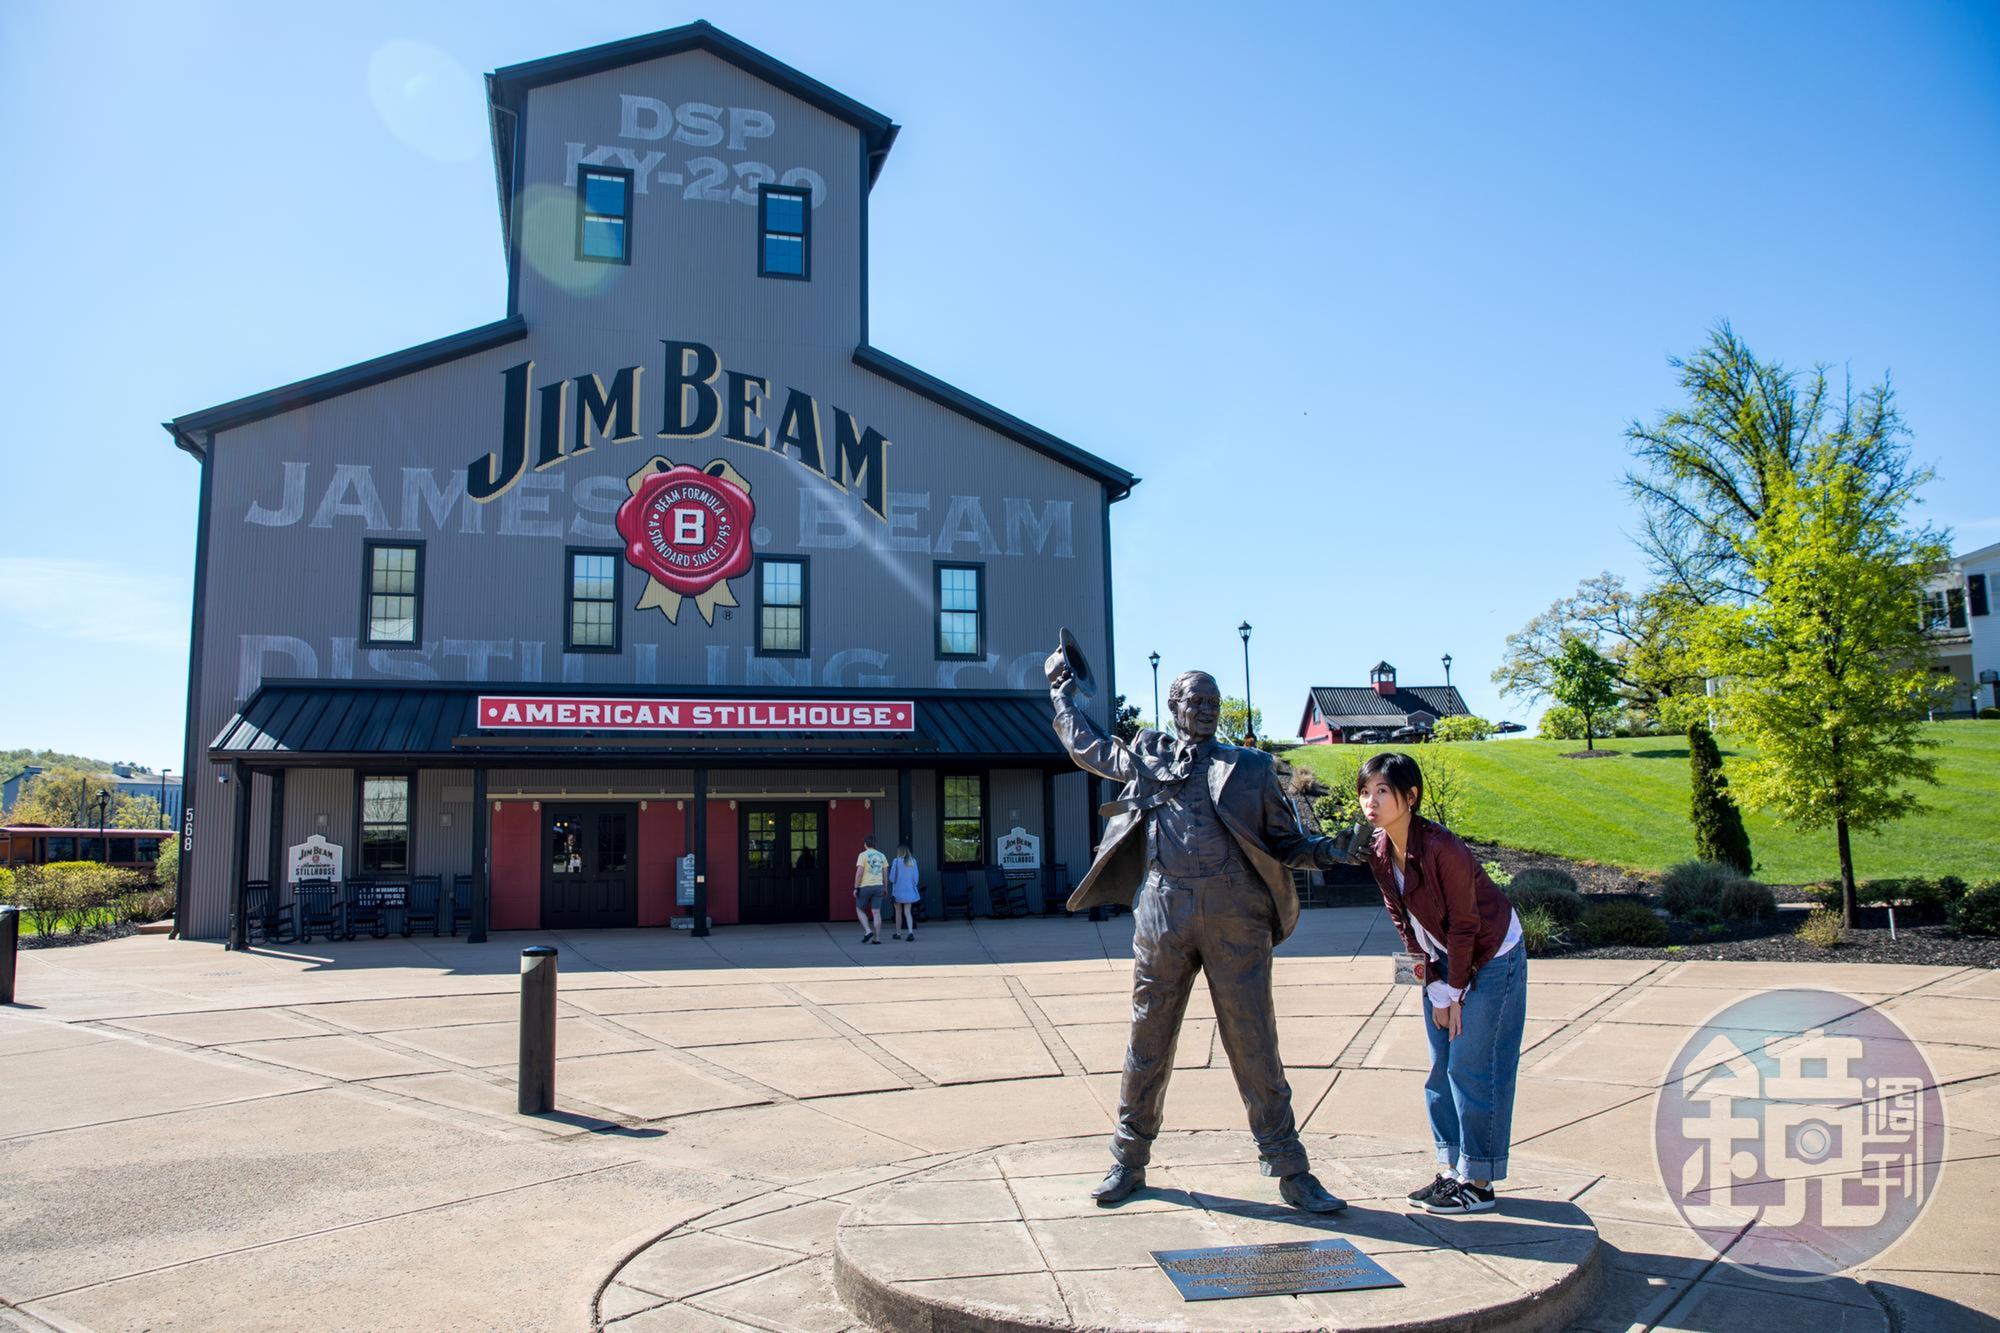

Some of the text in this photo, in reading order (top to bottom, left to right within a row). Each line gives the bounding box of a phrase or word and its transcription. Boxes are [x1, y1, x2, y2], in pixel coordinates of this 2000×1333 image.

[619, 94, 775, 150] DSP
[467, 339, 892, 522] JIM BEAM
[244, 461, 629, 540] JAMES
[655, 487, 725, 516] BEAM FORMULA
[797, 486, 1075, 559] BEAM
[649, 529, 690, 567] STANDARD
[693, 548, 720, 567] SINCE
[714, 524, 731, 550] 1795
[673, 508, 705, 545] B
[501, 703, 892, 725] AMERICAN STILLHOUSE
[184, 807, 194, 851] 568
